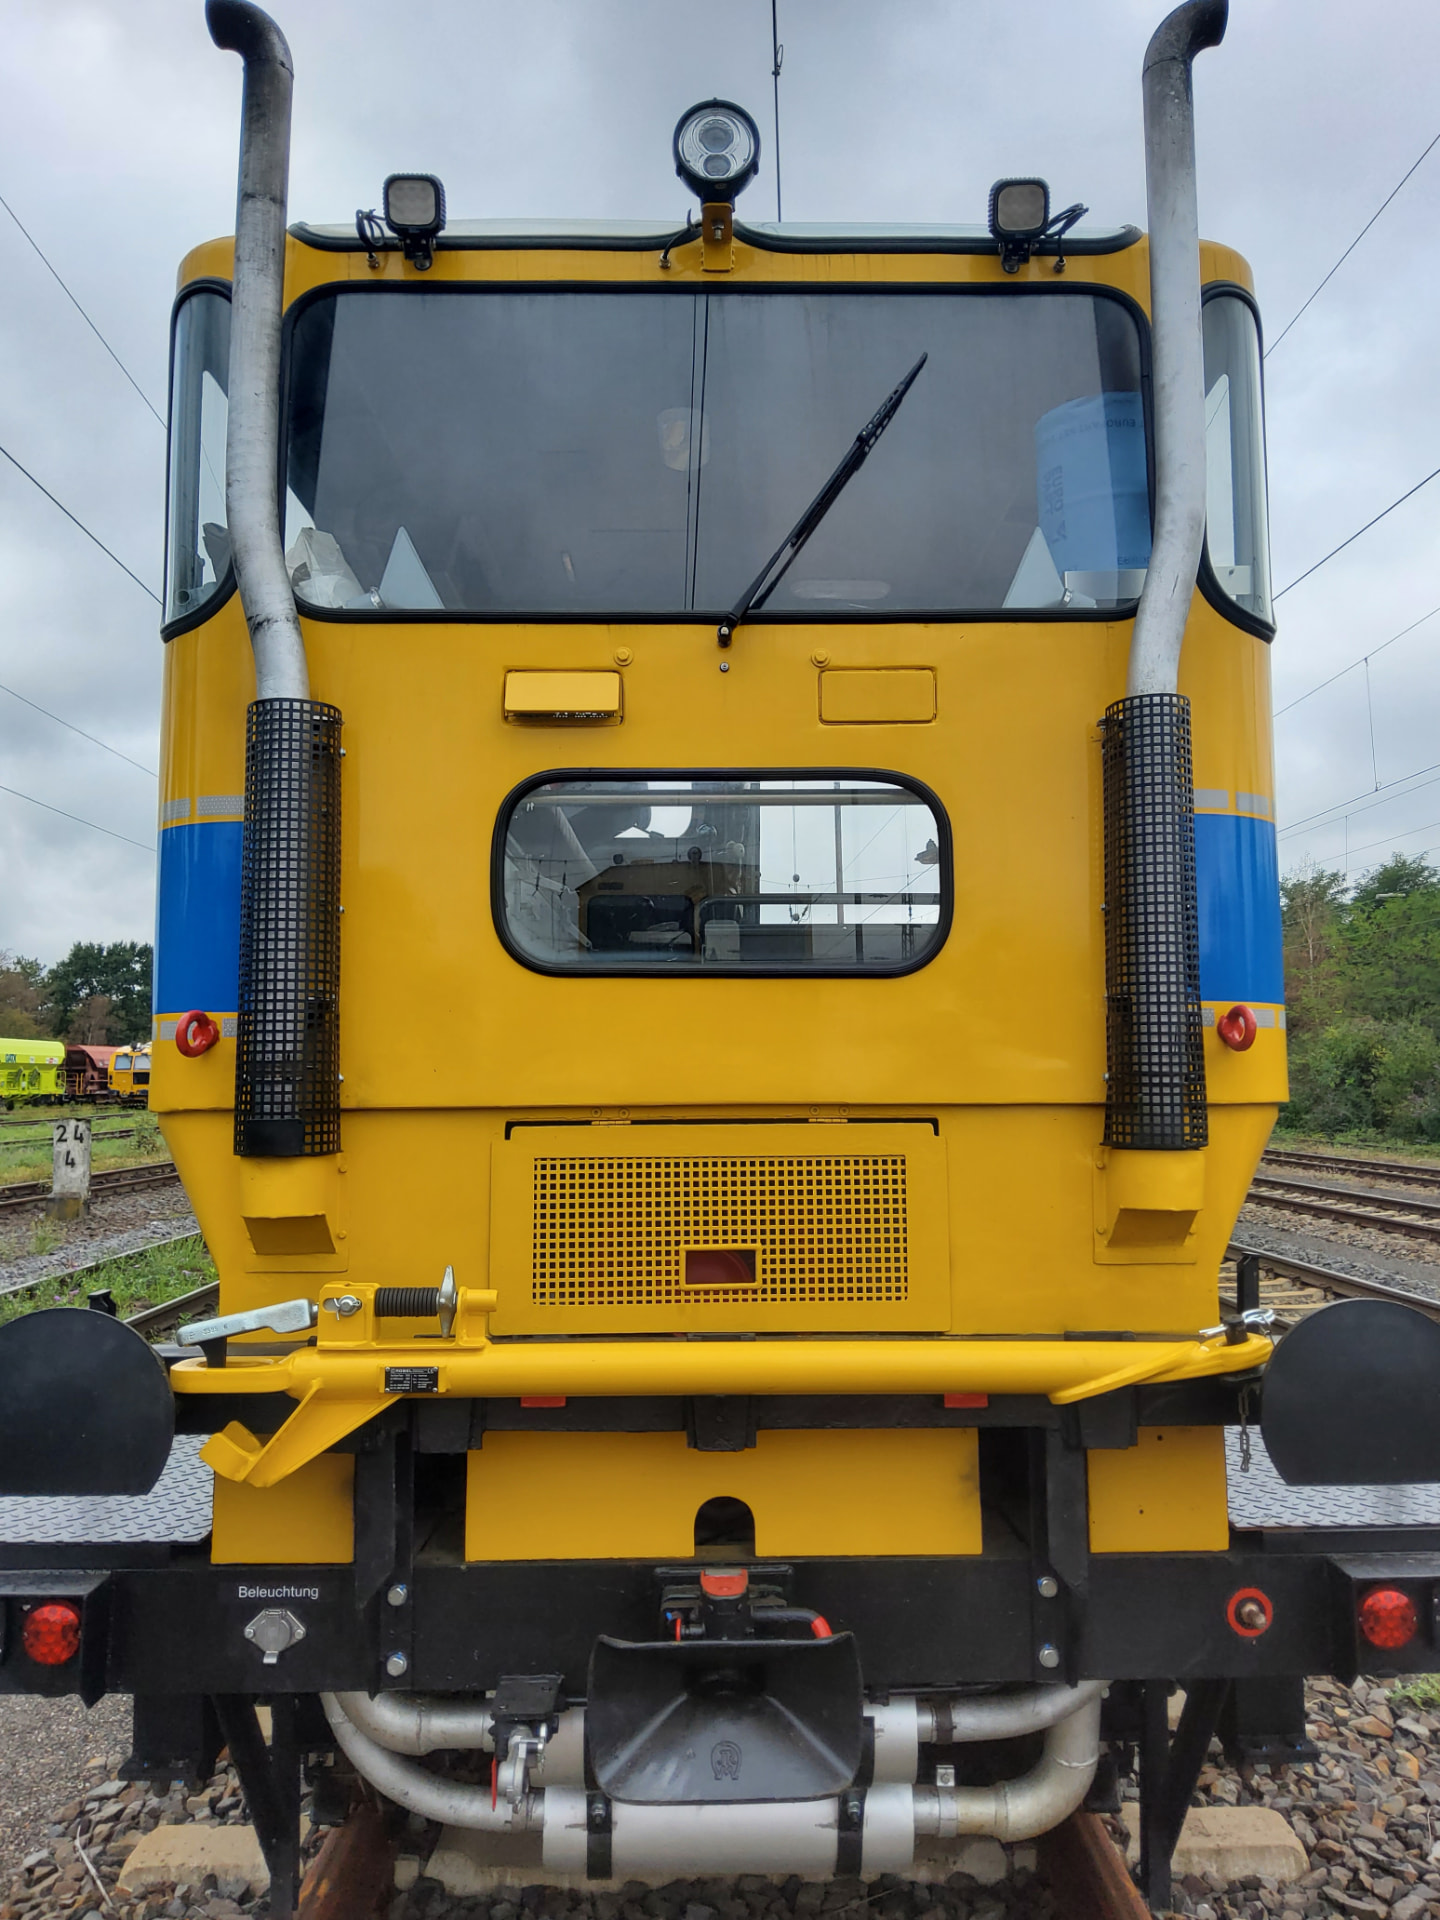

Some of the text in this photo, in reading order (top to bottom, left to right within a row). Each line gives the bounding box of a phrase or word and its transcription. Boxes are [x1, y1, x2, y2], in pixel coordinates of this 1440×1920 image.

[56, 1124, 84, 1143] 24
[65, 1150, 76, 1168] 4
[238, 1586, 319, 1600] Beleuchtung
